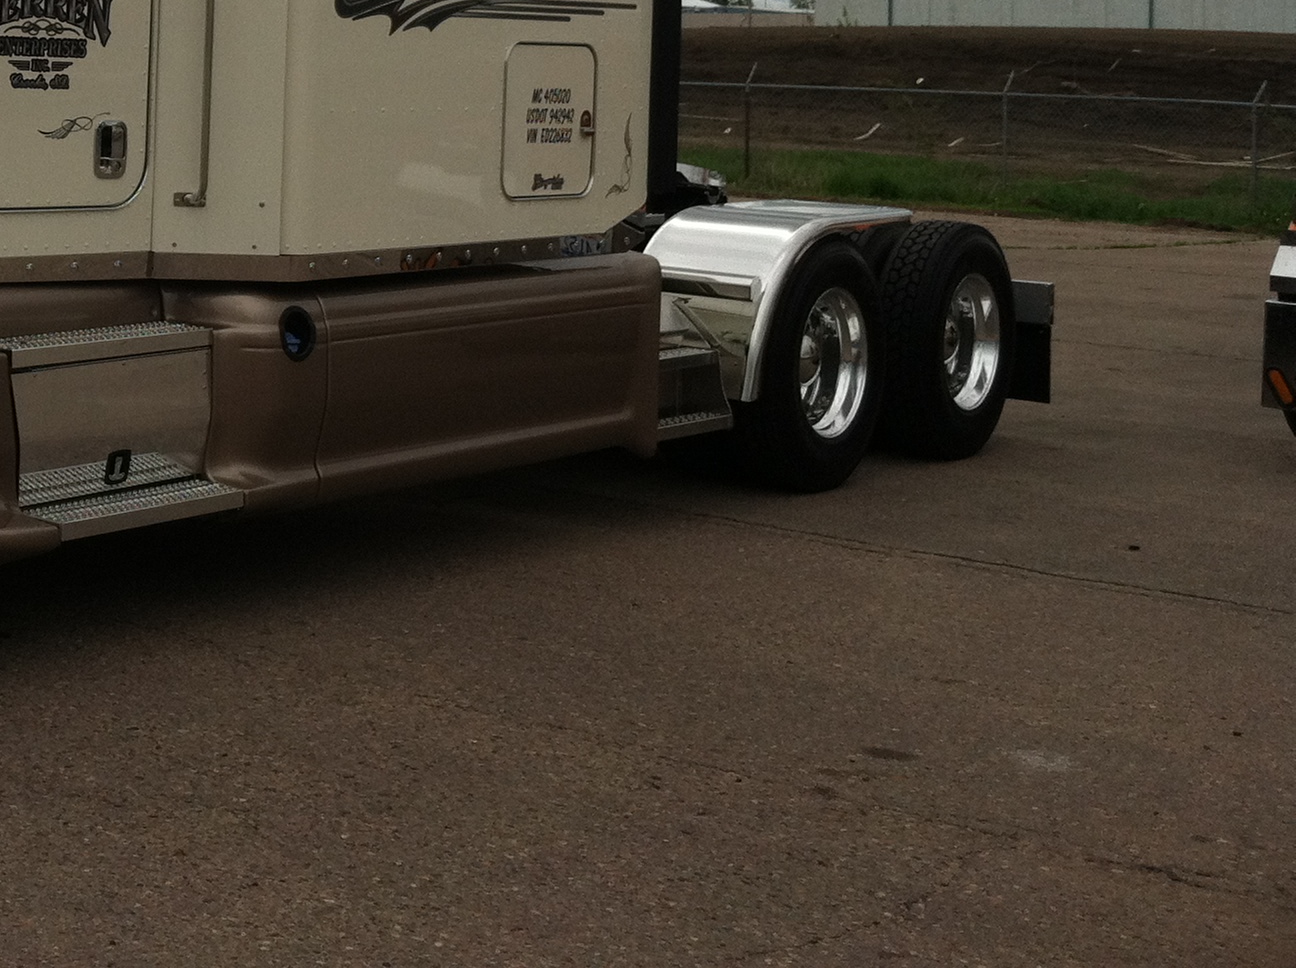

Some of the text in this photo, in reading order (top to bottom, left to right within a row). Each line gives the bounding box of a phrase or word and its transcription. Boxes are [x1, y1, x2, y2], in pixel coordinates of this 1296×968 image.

[531, 88, 543, 103] MC
[526, 108, 548, 123] USDOT
[526, 128, 538, 143] VIN
